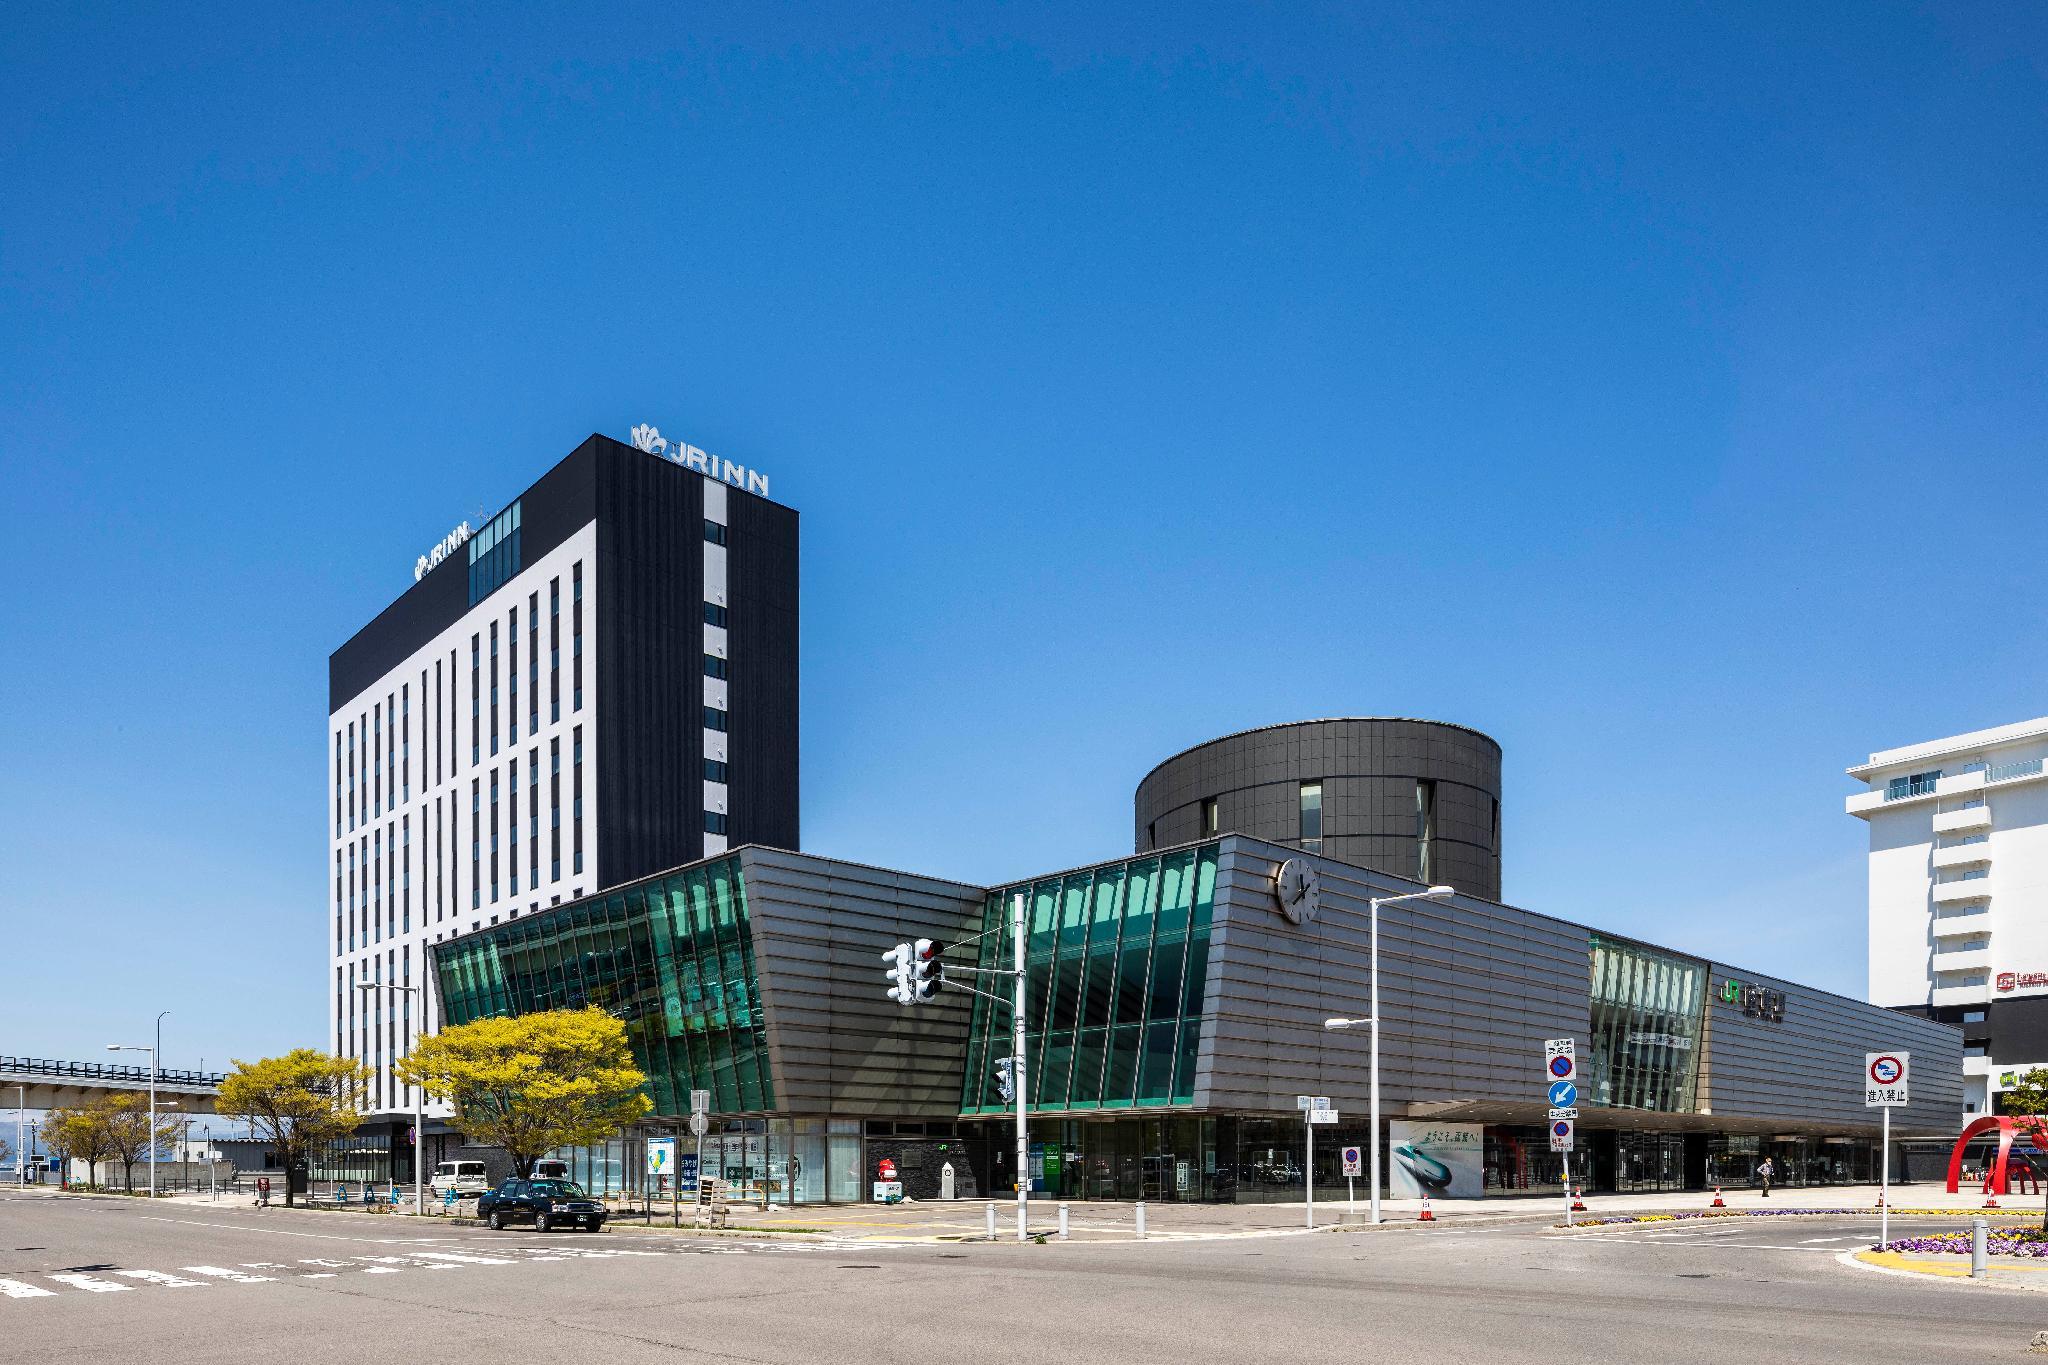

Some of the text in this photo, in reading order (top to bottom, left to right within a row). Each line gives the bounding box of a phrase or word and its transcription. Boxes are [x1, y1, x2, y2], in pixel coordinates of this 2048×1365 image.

[1720, 979, 1739, 1004] JR
[1867, 1089, 1906, 1103] 進入禁止
